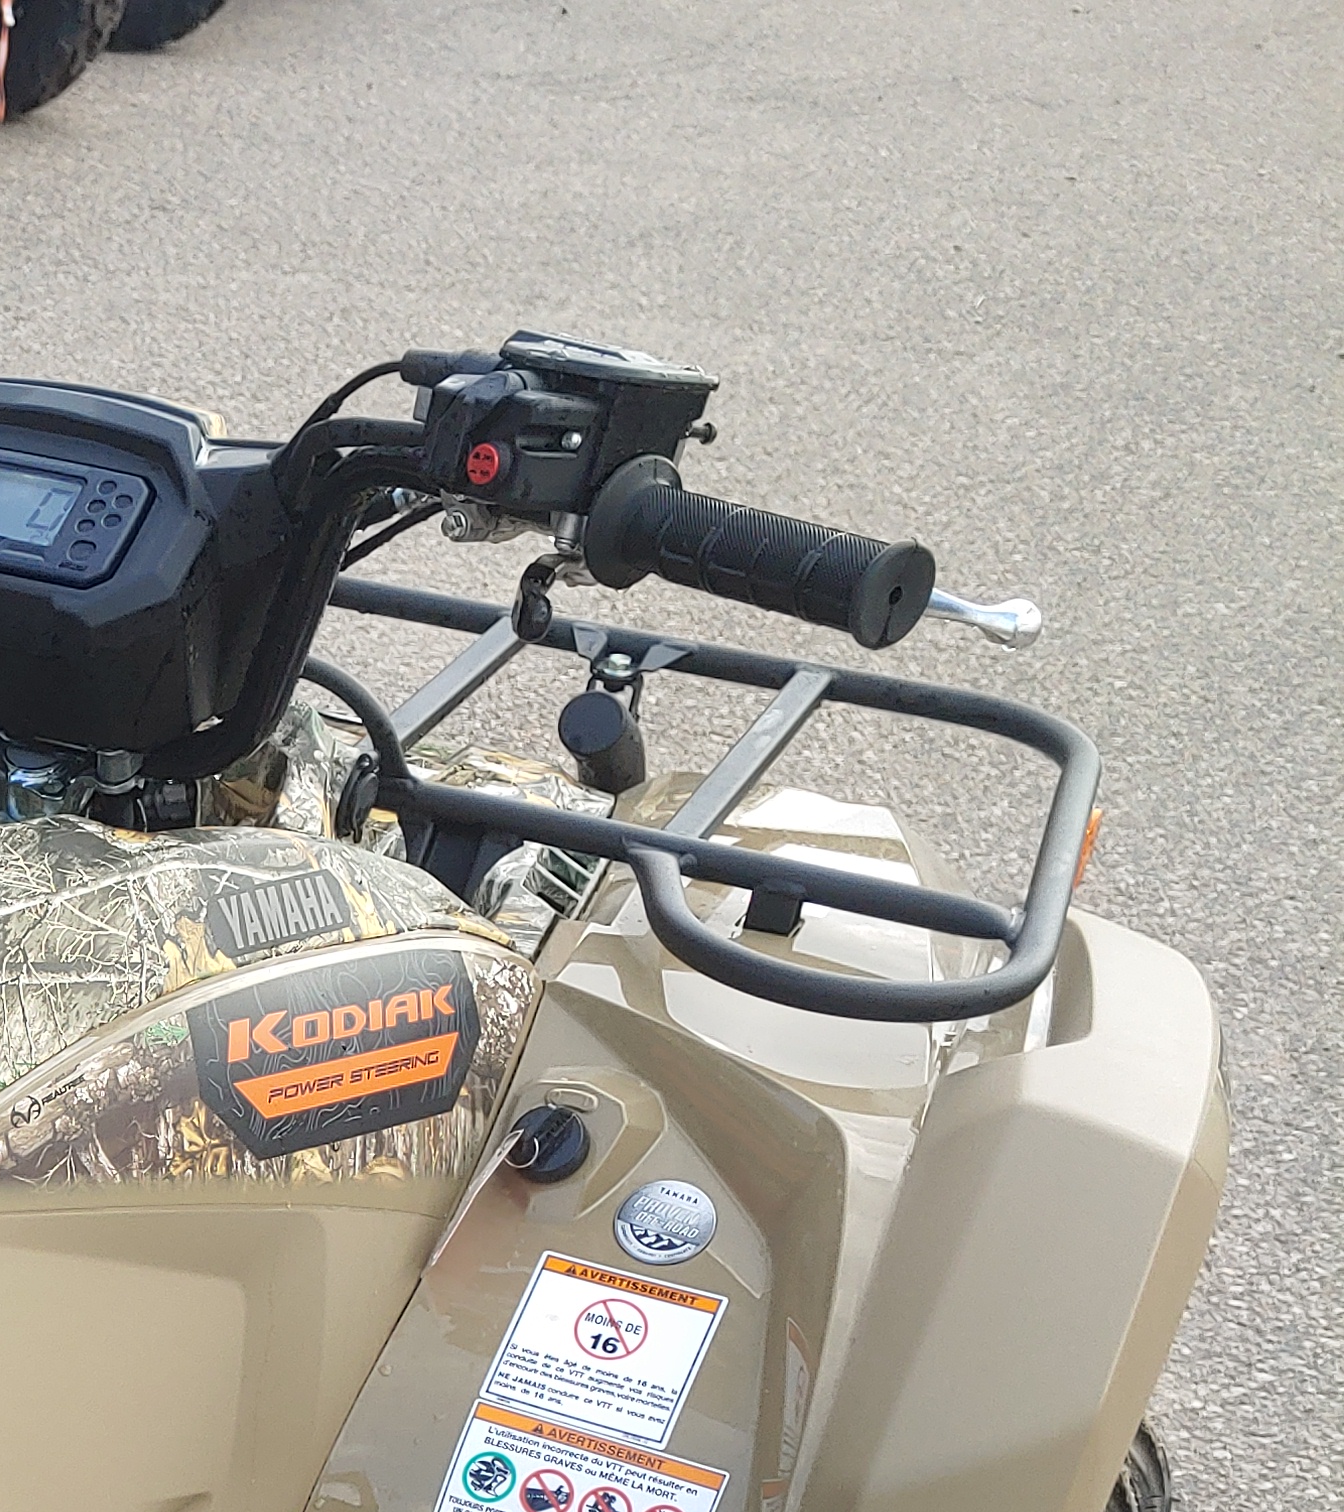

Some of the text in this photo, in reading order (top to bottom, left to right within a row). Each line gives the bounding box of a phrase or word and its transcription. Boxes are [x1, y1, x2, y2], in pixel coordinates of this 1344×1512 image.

[217, 874, 344, 950] YAMAHA
[227, 983, 456, 1065] KODIAK
[266, 1049, 441, 1104] POWER STEERING
[633, 1194, 701, 1225] PROVEN
[659, 1186, 699, 1205] YAMAHA
[635, 1210, 700, 1239] OFF-ROAD
[578, 1267, 698, 1305] AVERTISSEMENT
[583, 1311, 643, 1336] MOINS DE
[589, 1332, 623, 1354] 16
[496, 1370, 511, 1380] NE
[510, 1375, 547, 1391] JAMAIS
[595, 1398, 613, 1410] VTT
[568, 1368, 585, 1379] VTT
[546, 1427, 666, 1470] AVERTISSEMENT
[482, 1435, 542, 1460] BLESSURES
[542, 1453, 584, 1472] GRAVES
[583, 1467, 598, 1477] ou
[629, 1479, 644, 1492] LA
[644, 1484, 677, 1502] MORT.
[589, 1456, 604, 1467] du
[604, 1459, 625, 1473] VTT
[623, 1467, 647, 1481] peut
[684, 1486, 698, 1497] en
